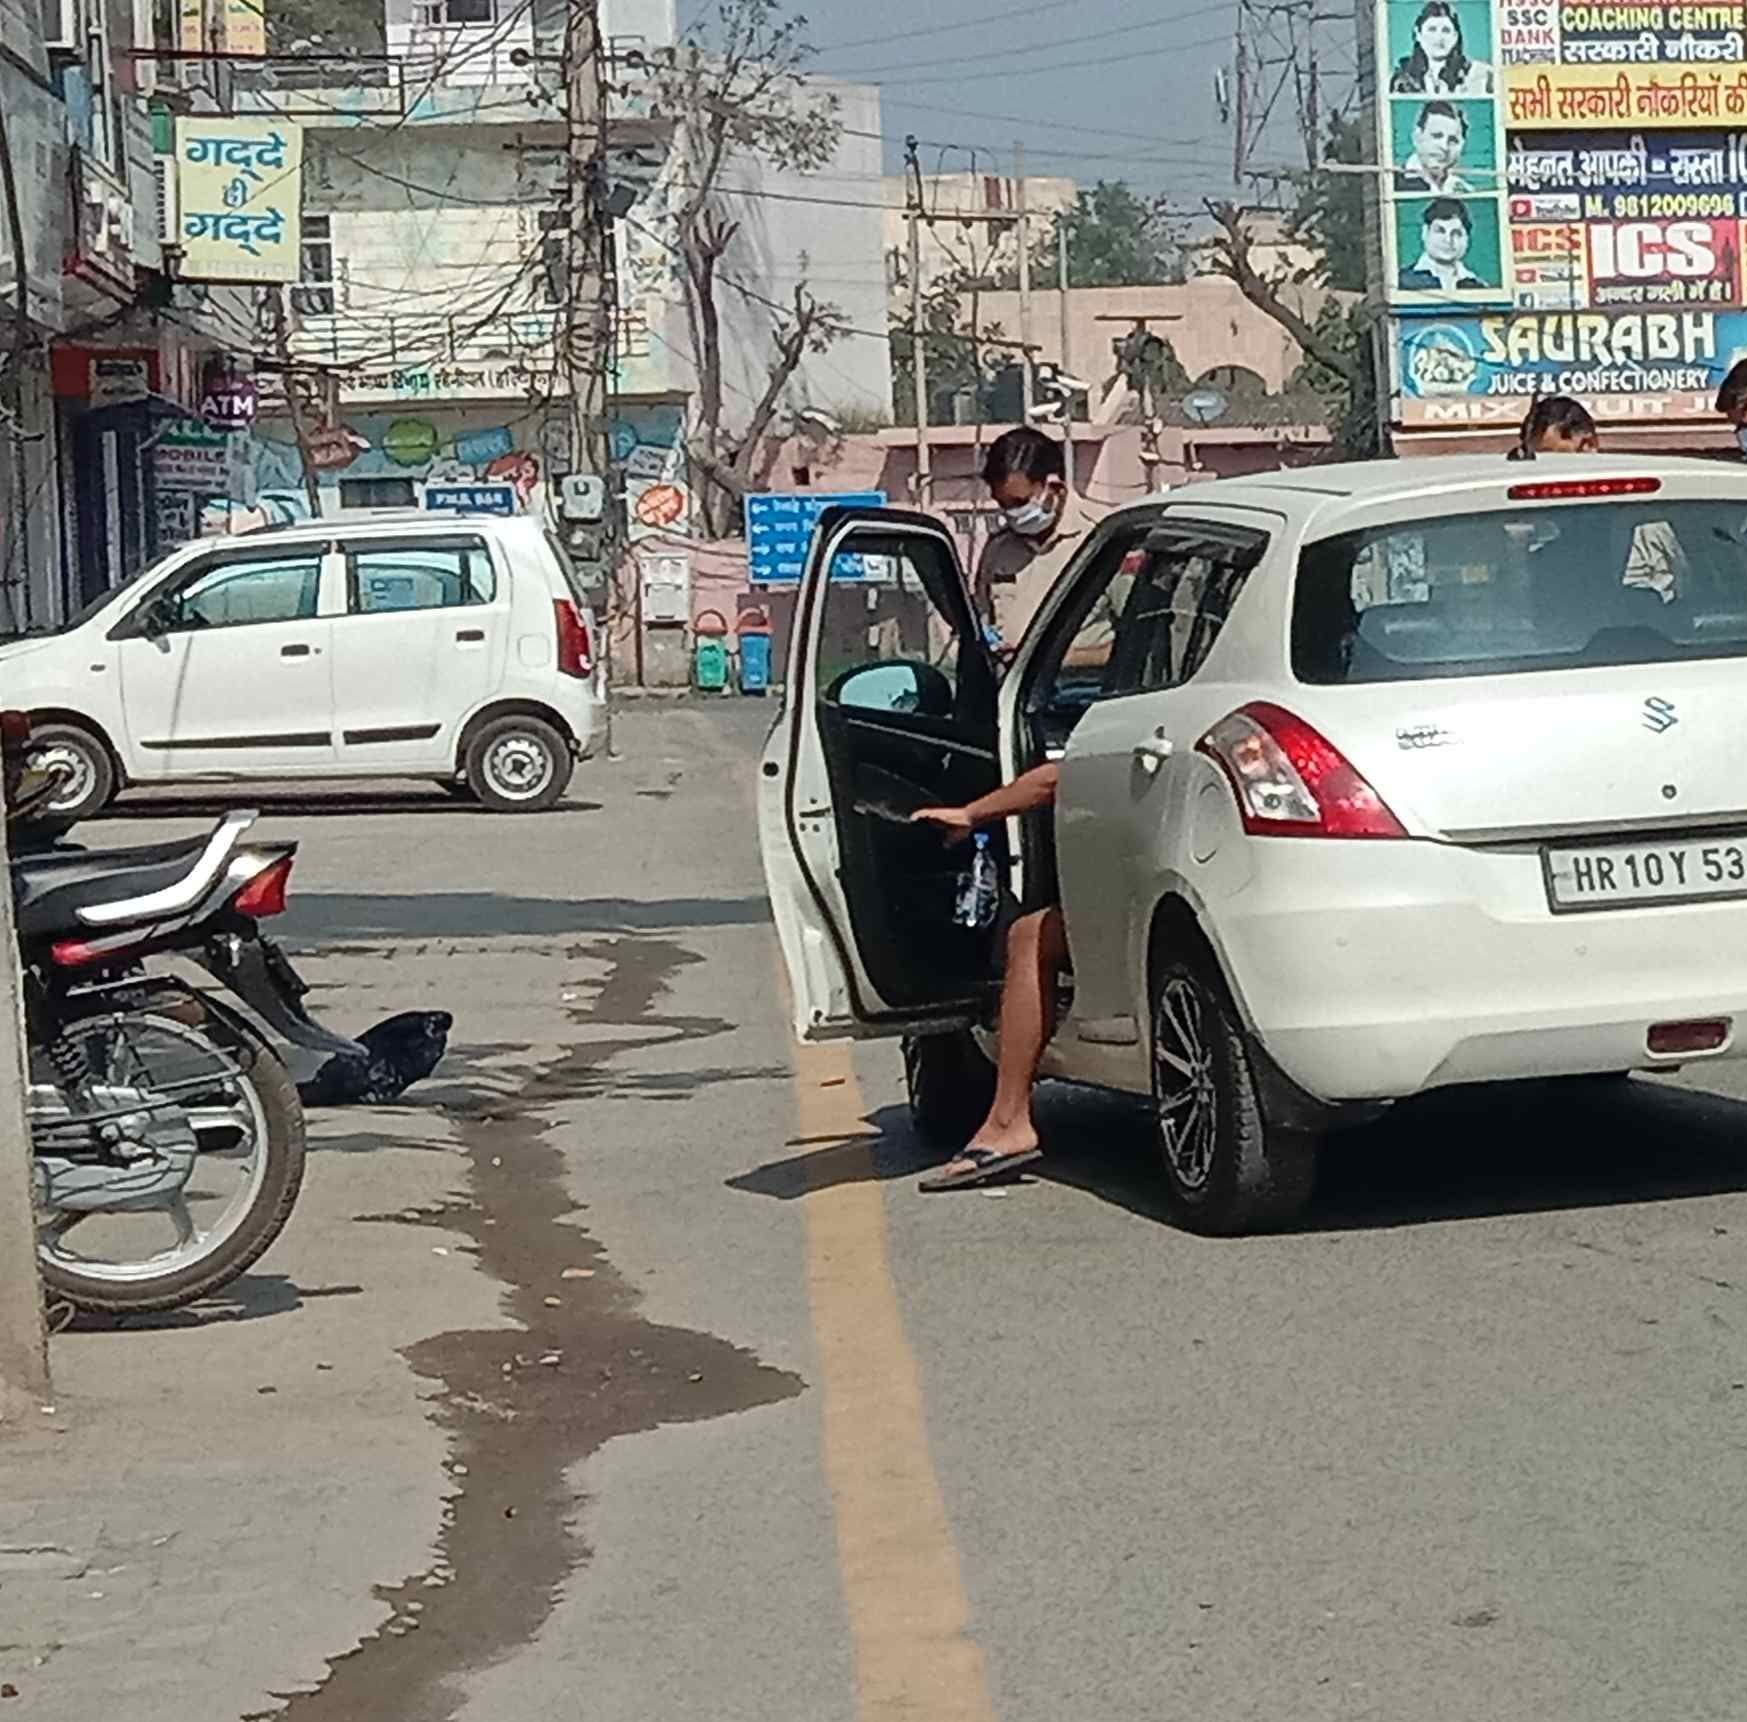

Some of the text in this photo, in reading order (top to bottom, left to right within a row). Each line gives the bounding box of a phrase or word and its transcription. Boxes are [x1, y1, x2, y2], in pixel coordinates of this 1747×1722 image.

[1507, 9, 1549, 26] SSC
[1562, 6, 1746, 32] COACHING CENTRE
[1501, 29, 1555, 45] BANK
[1563, 33, 1659, 63] सरकारी
[1508, 74, 1552, 119] सभी
[1556, 71, 1632, 118] सरकारी
[185, 132, 286, 182] गद्दे
[1578, 134, 1647, 187] आपकी
[1614, 193, 1735, 218] 9812009696
[183, 206, 286, 257] गद्दे
[1511, 227, 1581, 254] ICS
[1589, 220, 1716, 279] ICS
[1480, 312, 1716, 367] SAURABH
[1486, 368, 1709, 395] JUICE & CONFECTIONERY
[200, 395, 253, 416] ATM
[1423, 402, 1525, 421] MIX
